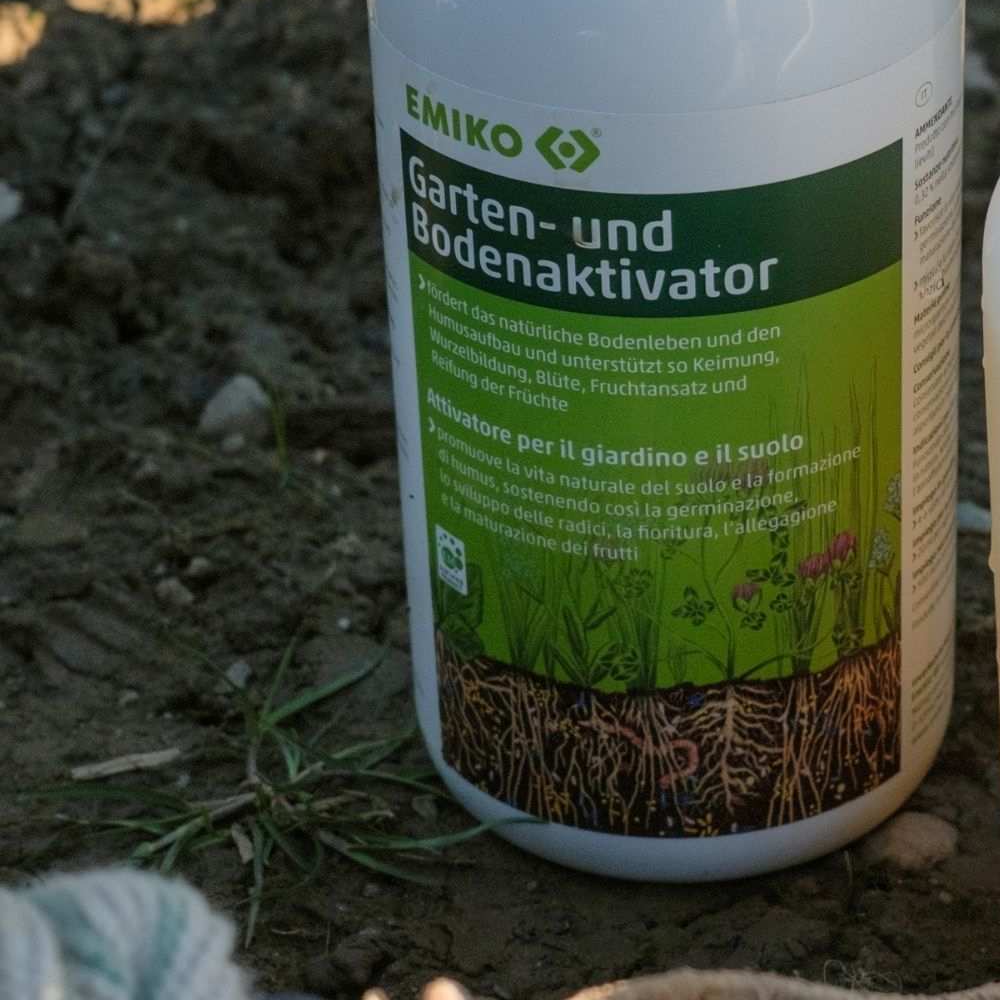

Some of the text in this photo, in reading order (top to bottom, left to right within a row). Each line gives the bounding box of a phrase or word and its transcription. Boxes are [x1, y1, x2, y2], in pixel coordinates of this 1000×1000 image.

[405, 83, 523, 159] EMIKO
[407, 154, 673, 252] Garten- und
[412, 202, 779, 302] Bodenaktivator
[427, 279, 781, 350] fördert das natürliche Bodenleben und den
[428, 304, 780, 374] Humusaufbau und unterstützt so Keimung,
[429, 327, 748, 397] Wurzelbildung, Blüte, Fruchtansatz und
[431, 349, 569, 412] Reifung der Früchte
[427, 388, 804, 467] Attivatore per il giardino e il suolo
[437, 427, 862, 496] promuove la vita naturale del suolo e la formazione
[450, 454, 500, 493] humus,
[503, 481, 601, 514] sostenendo
[605, 499, 640, 518] così
[645, 502, 662, 518] la
[667, 490, 799, 521] germinazione,
[453, 480, 511, 516] sviluppo
[513, 506, 554, 529] delle
[559, 518, 612, 539] radici,
[616, 523, 633, 539] la
[638, 524, 719, 540] fioritura,
[463, 506, 559, 551] maturazione
[561, 540, 588, 557] dei
[592, 543, 640, 560] frutti
